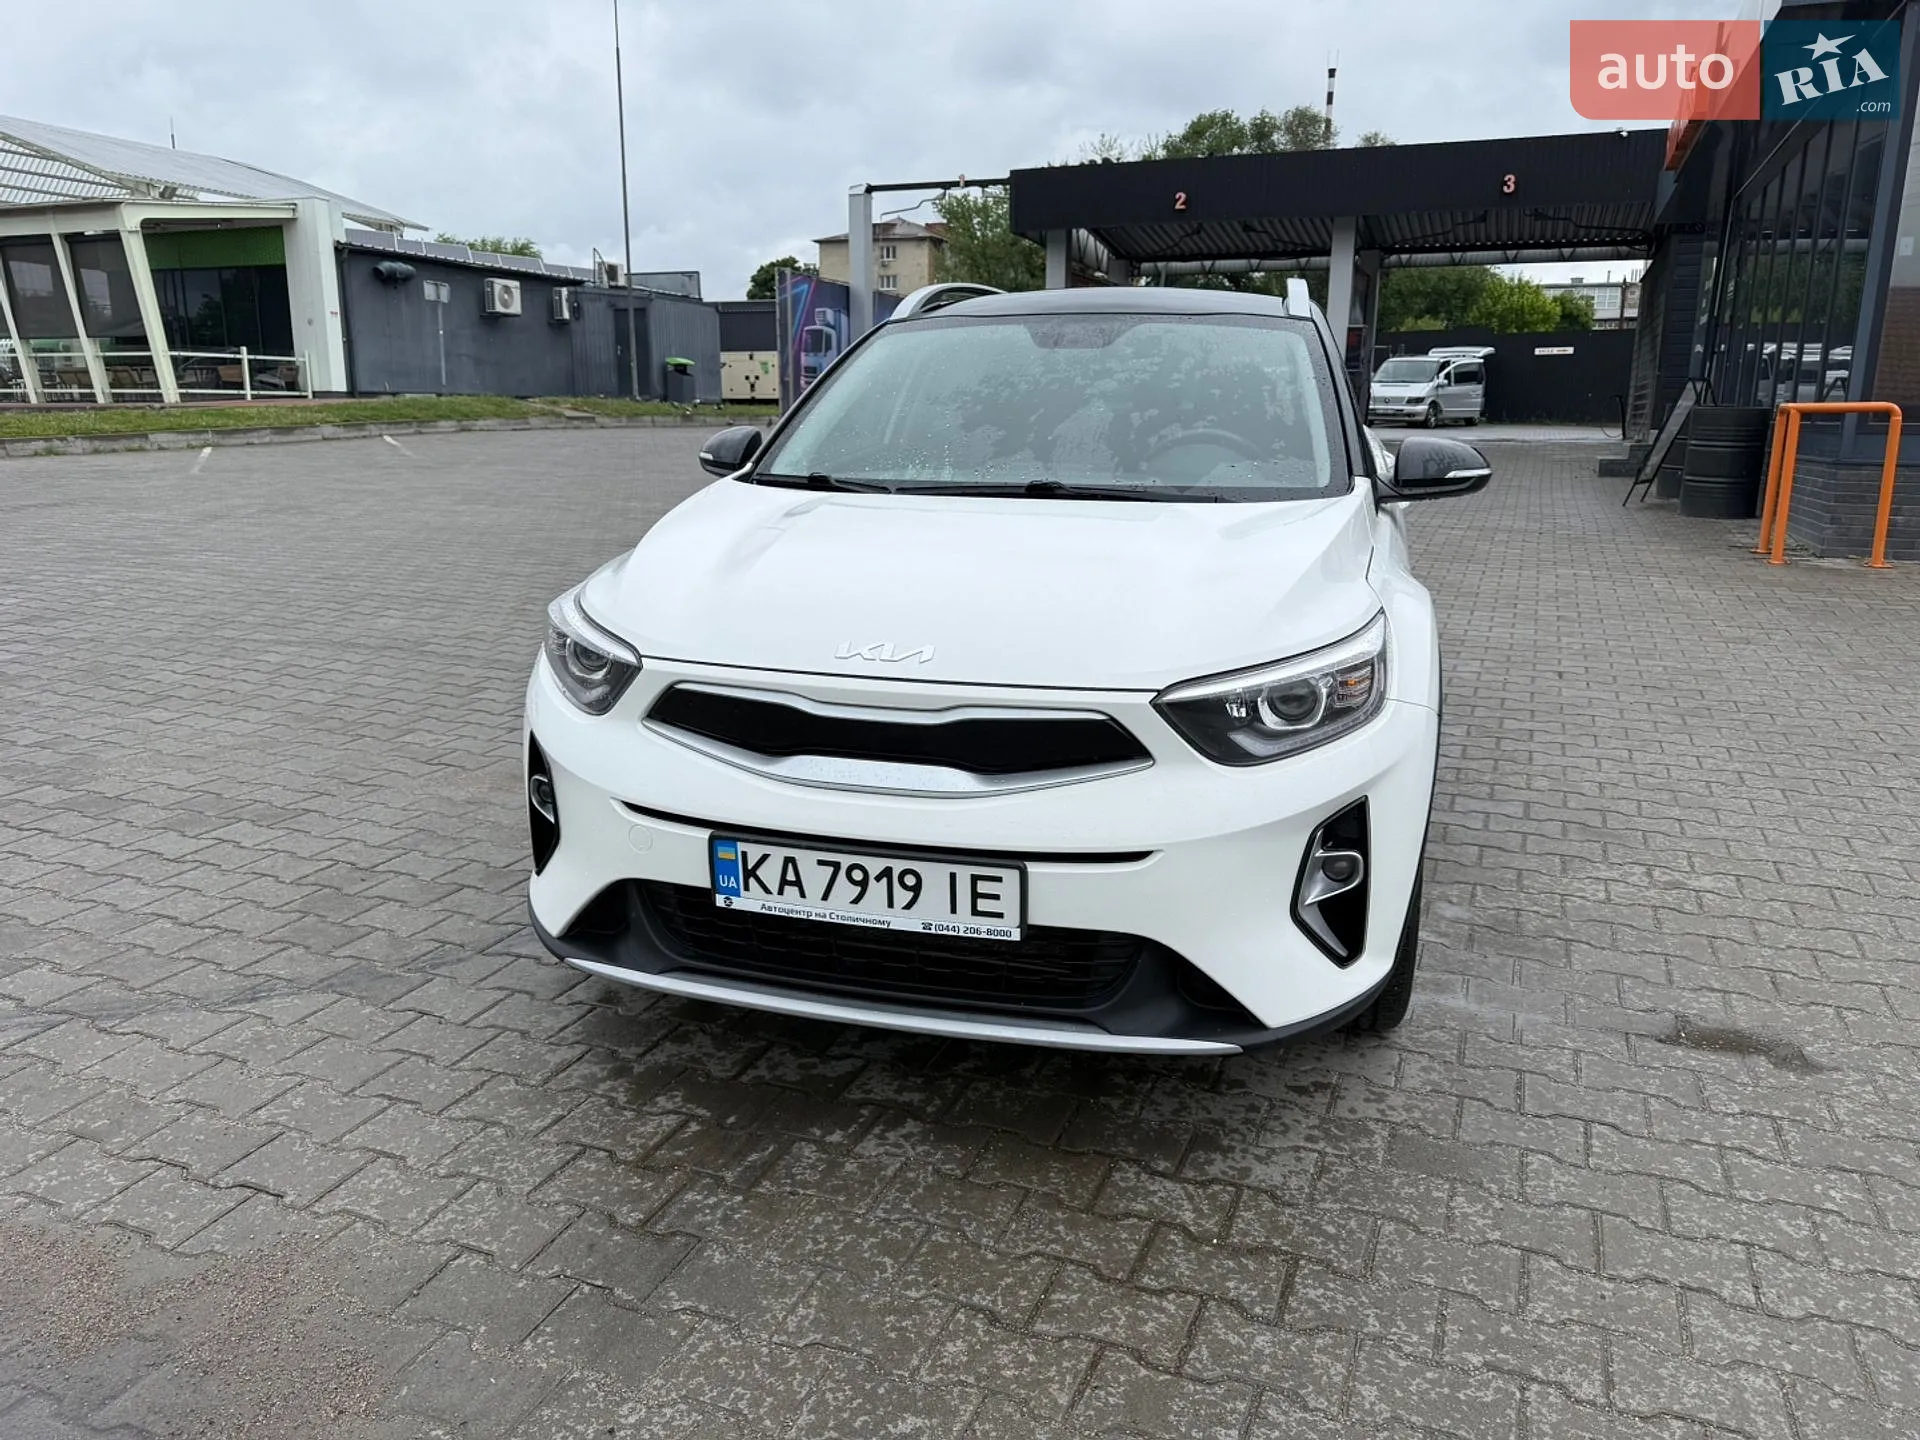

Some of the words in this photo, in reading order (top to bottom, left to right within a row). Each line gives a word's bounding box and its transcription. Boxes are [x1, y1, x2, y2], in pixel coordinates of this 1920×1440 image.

[1502, 174, 1516, 194] 3
[1174, 191, 1188, 210] 2
[719, 874, 738, 889] UA
[741, 850, 807, 899] KA
[816, 858, 923, 911] 7919
[949, 871, 1005, 920] IE
[760, 902, 813, 919] Автоцентр
[814, 911, 828, 920] на
[828, 911, 892, 928] Столичному
[934, 923, 960, 935] (044)
[962, 924, 1013, 939] 206-8000
